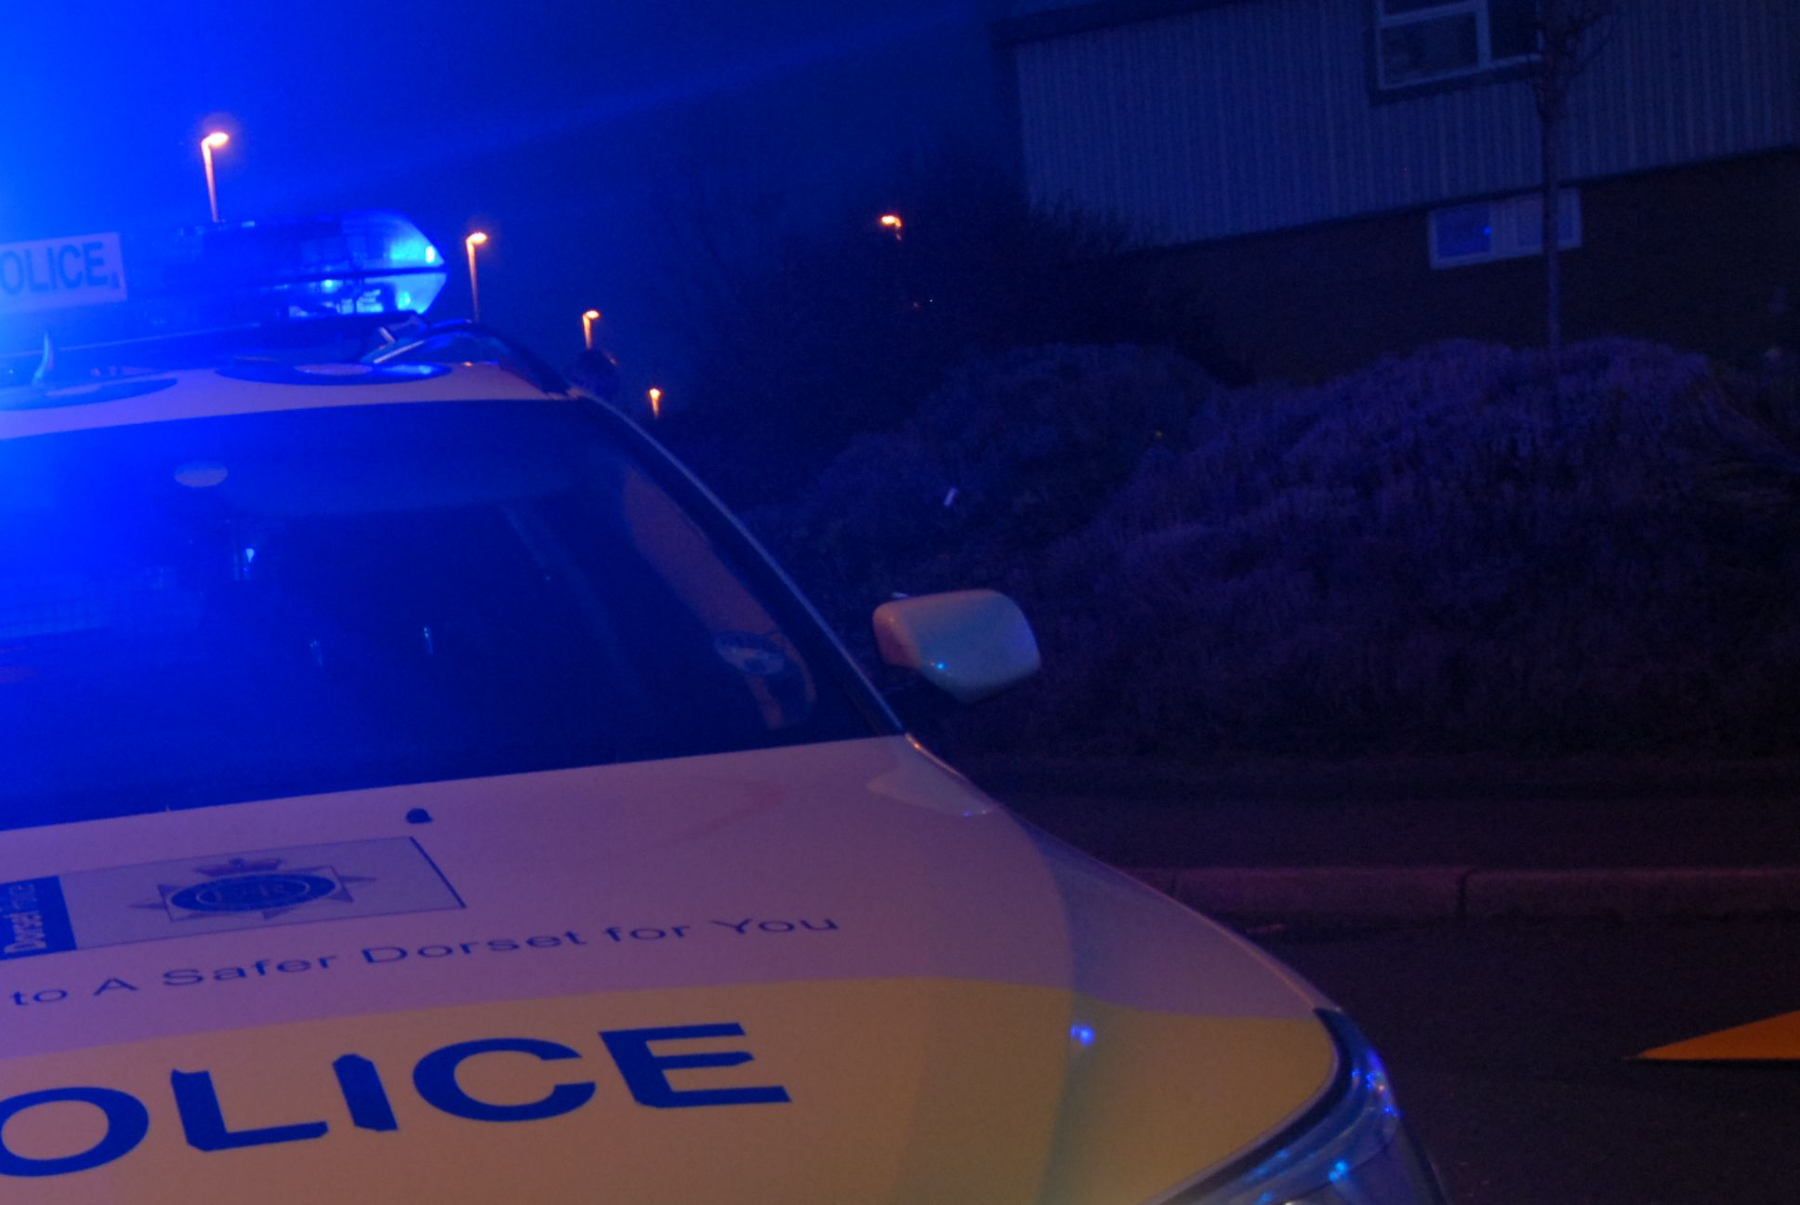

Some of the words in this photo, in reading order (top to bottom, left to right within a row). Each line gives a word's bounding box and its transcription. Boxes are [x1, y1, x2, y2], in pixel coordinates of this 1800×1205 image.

[12, 988, 68, 1006] to
[95, 977, 138, 996] A
[163, 954, 338, 987] Safer
[360, 929, 588, 964] Dorset
[602, 921, 692, 943] for
[710, 915, 839, 935] You
